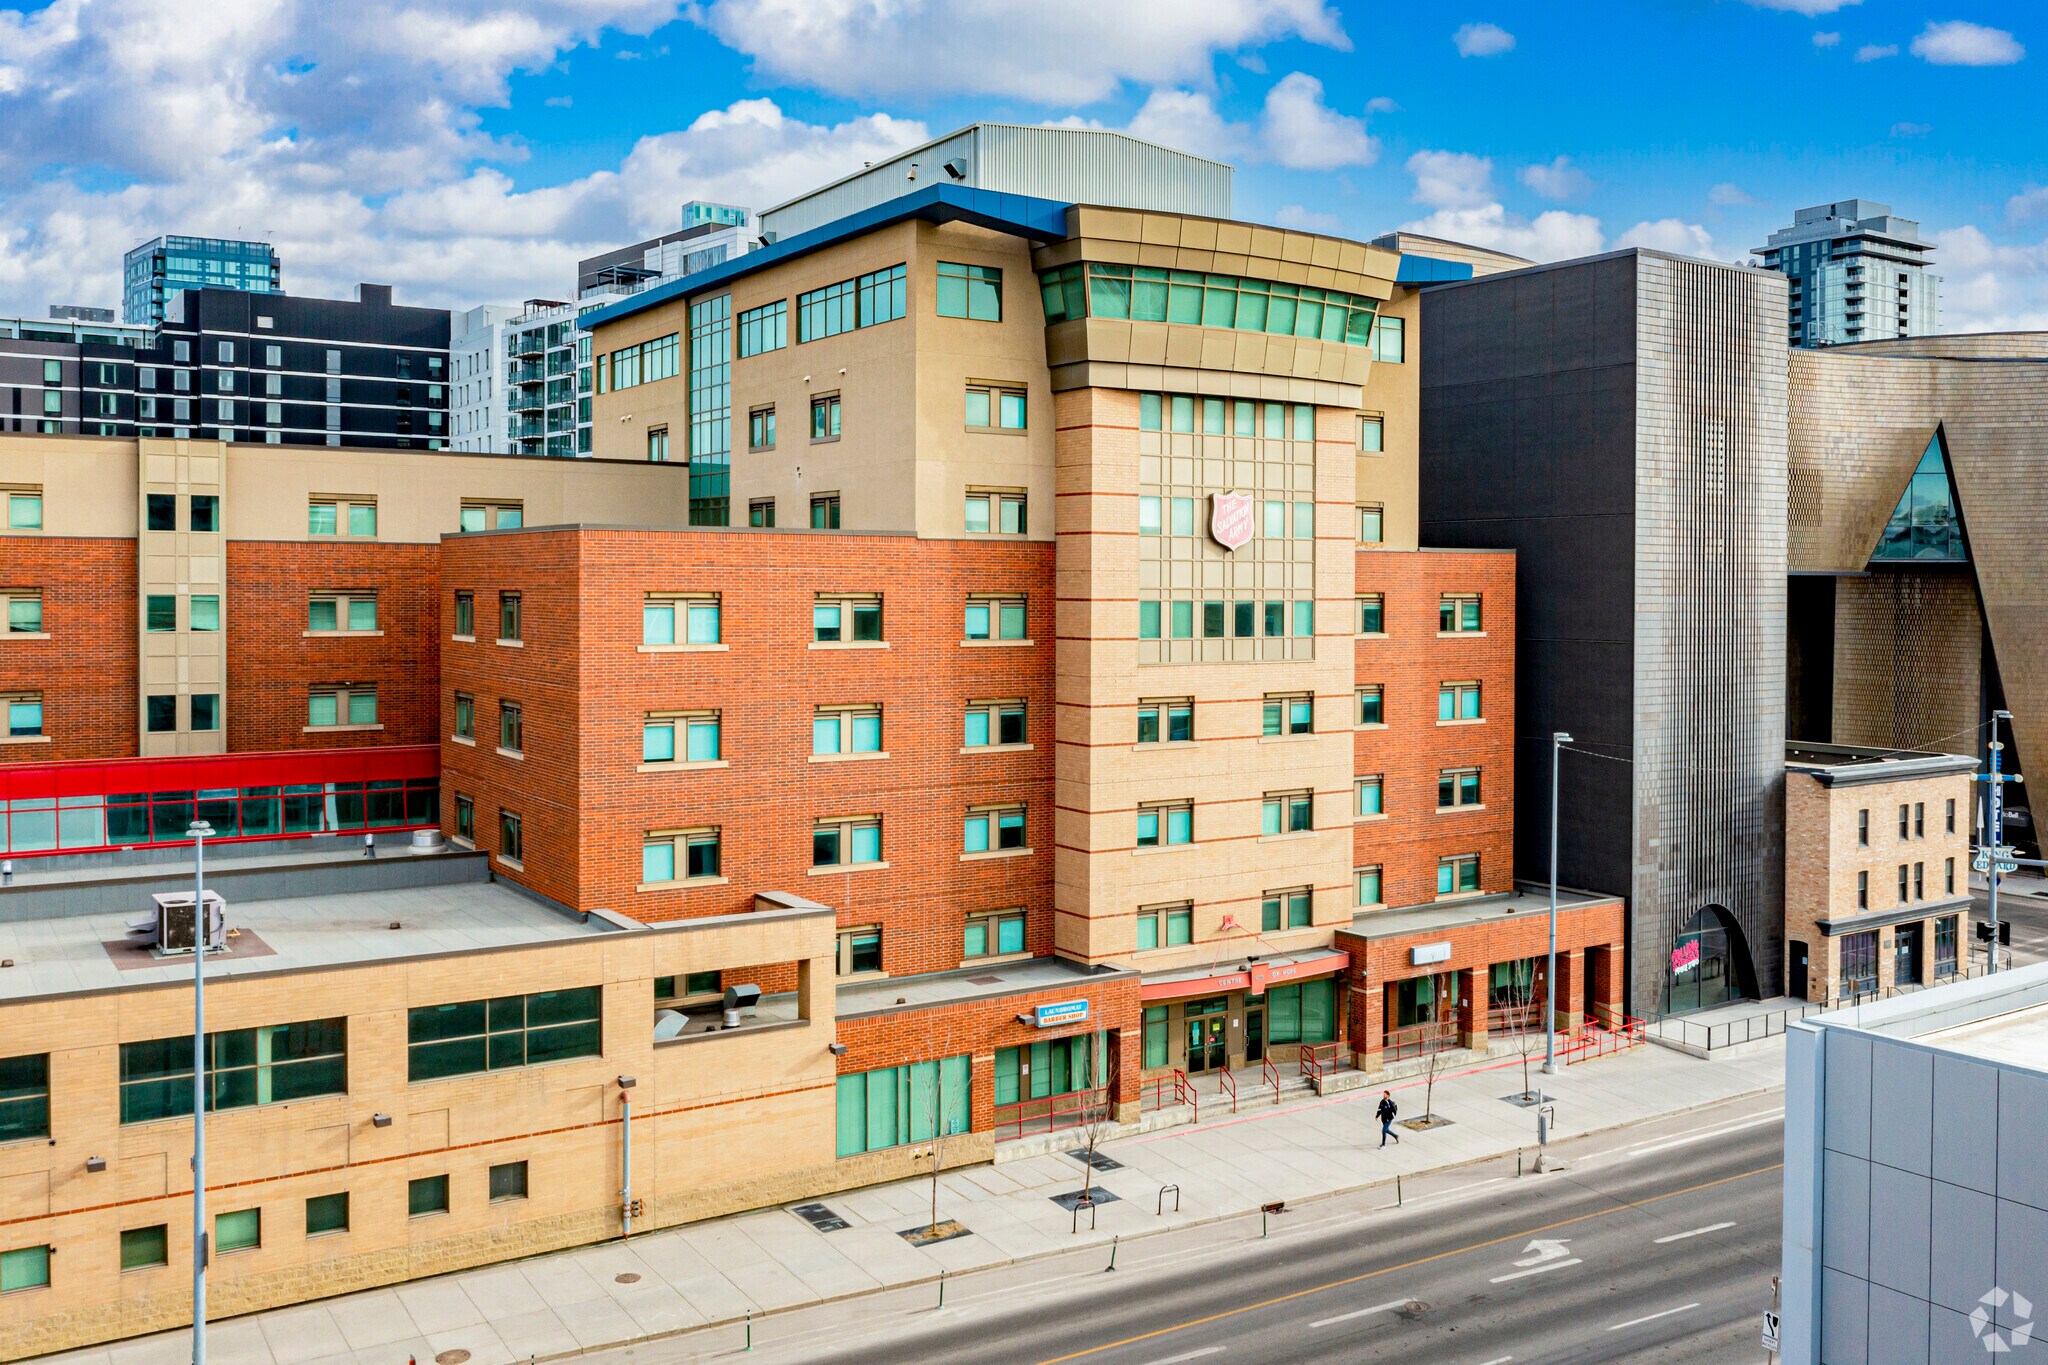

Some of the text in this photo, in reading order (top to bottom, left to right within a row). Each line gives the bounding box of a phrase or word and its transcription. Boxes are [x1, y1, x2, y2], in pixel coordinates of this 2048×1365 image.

[1221, 499, 1238, 516] THE
[1216, 501, 1250, 535] SALVATION
[1228, 517, 1249, 542] ARMY
[1981, 850, 2010, 859] KNG
[1976, 861, 2016, 871] EDARD
[1218, 977, 1242, 986] CENTRE
[1044, 1004, 1083, 1015] LAUNDROMAT
[1043, 1015, 1067, 1024] BARBER
